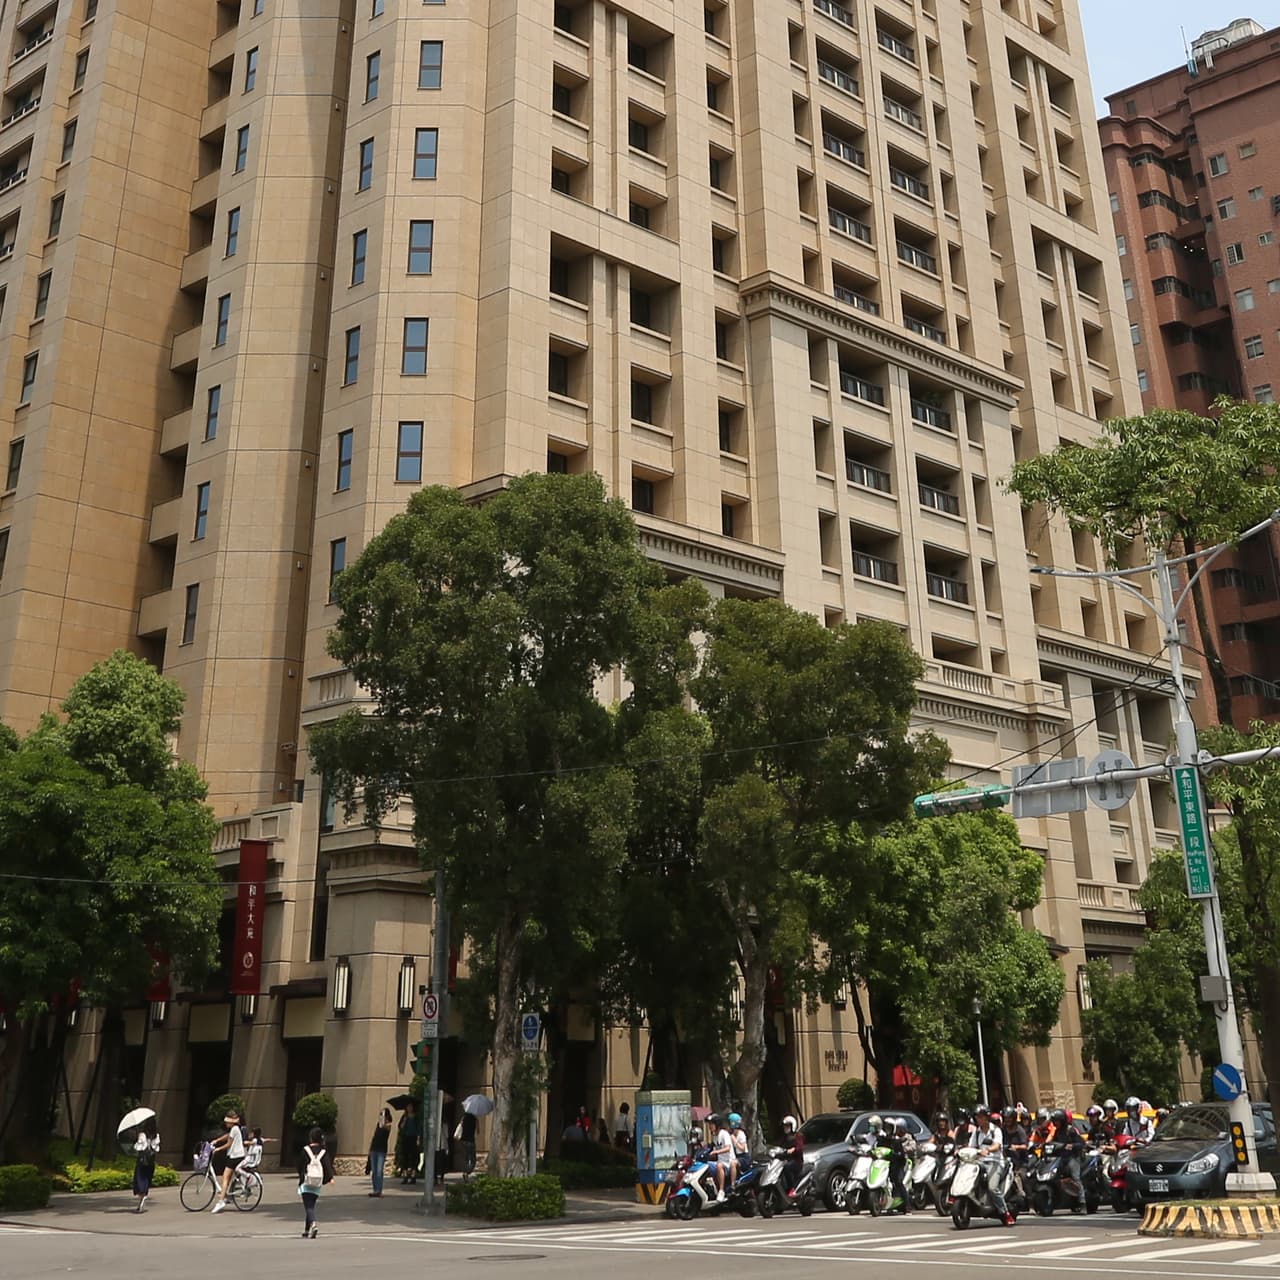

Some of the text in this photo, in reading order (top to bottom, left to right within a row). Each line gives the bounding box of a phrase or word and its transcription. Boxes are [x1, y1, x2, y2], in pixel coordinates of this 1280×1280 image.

[1182, 779, 1201, 848] 和平東路一段
